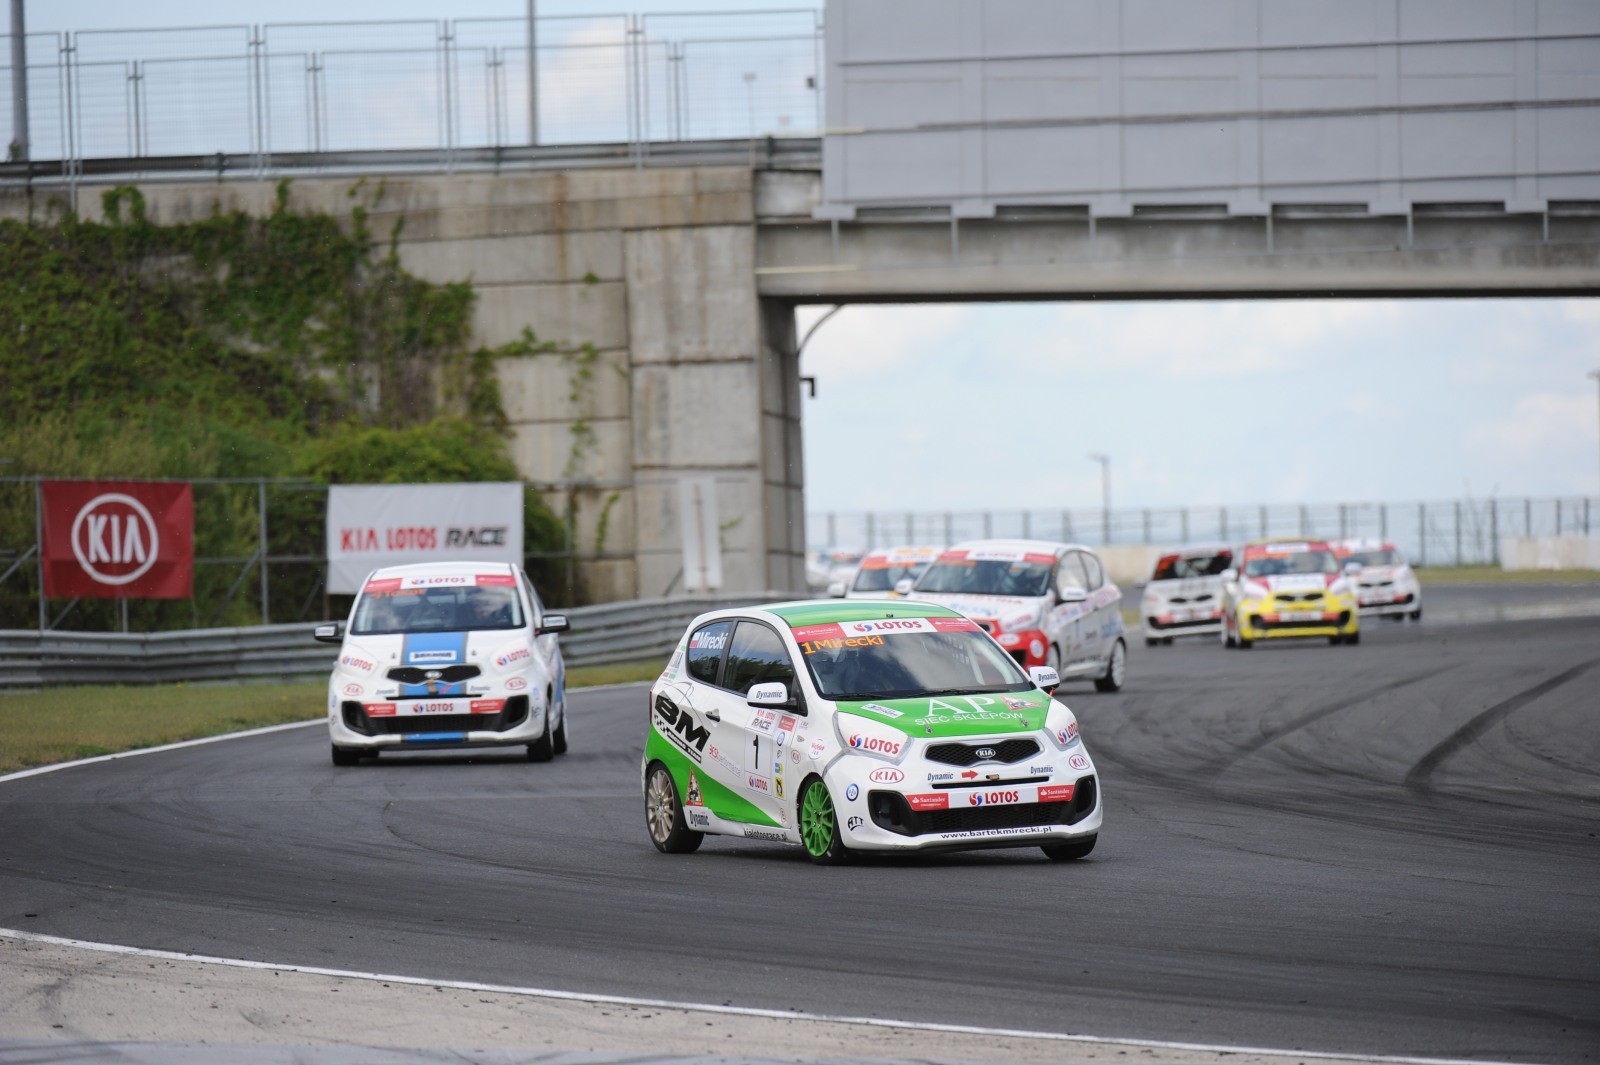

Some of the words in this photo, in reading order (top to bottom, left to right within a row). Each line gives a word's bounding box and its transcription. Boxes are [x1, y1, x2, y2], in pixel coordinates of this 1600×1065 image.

[86, 514, 146, 564] KIA
[340, 528, 379, 551] KIA
[387, 527, 437, 550] LOTOS
[446, 526, 508, 547] RACE
[873, 621, 922, 631] LOTOS
[697, 632, 728, 650] Mirecki
[814, 634, 884, 650] Mirecki
[1038, 673, 1057, 682] Dynamic
[756, 690, 783, 699] Dynamic
[426, 703, 454, 712] LOTOS
[925, 696, 996, 717] AP
[655, 695, 711, 752] BM
[752, 734, 760, 770] 1
[863, 737, 900, 755] LOTOS
[979, 749, 994, 757] KIA
[1030, 765, 1054, 775] Dynamic
[1072, 757, 1087, 769] KIA
[874, 771, 898, 781] KIA
[927, 772, 954, 782] Dynamic
[754, 777, 769, 792] LOTOS
[984, 790, 1019, 805] LOTOS
[940, 826, 1052, 839] www.bartekmirecki.pl
